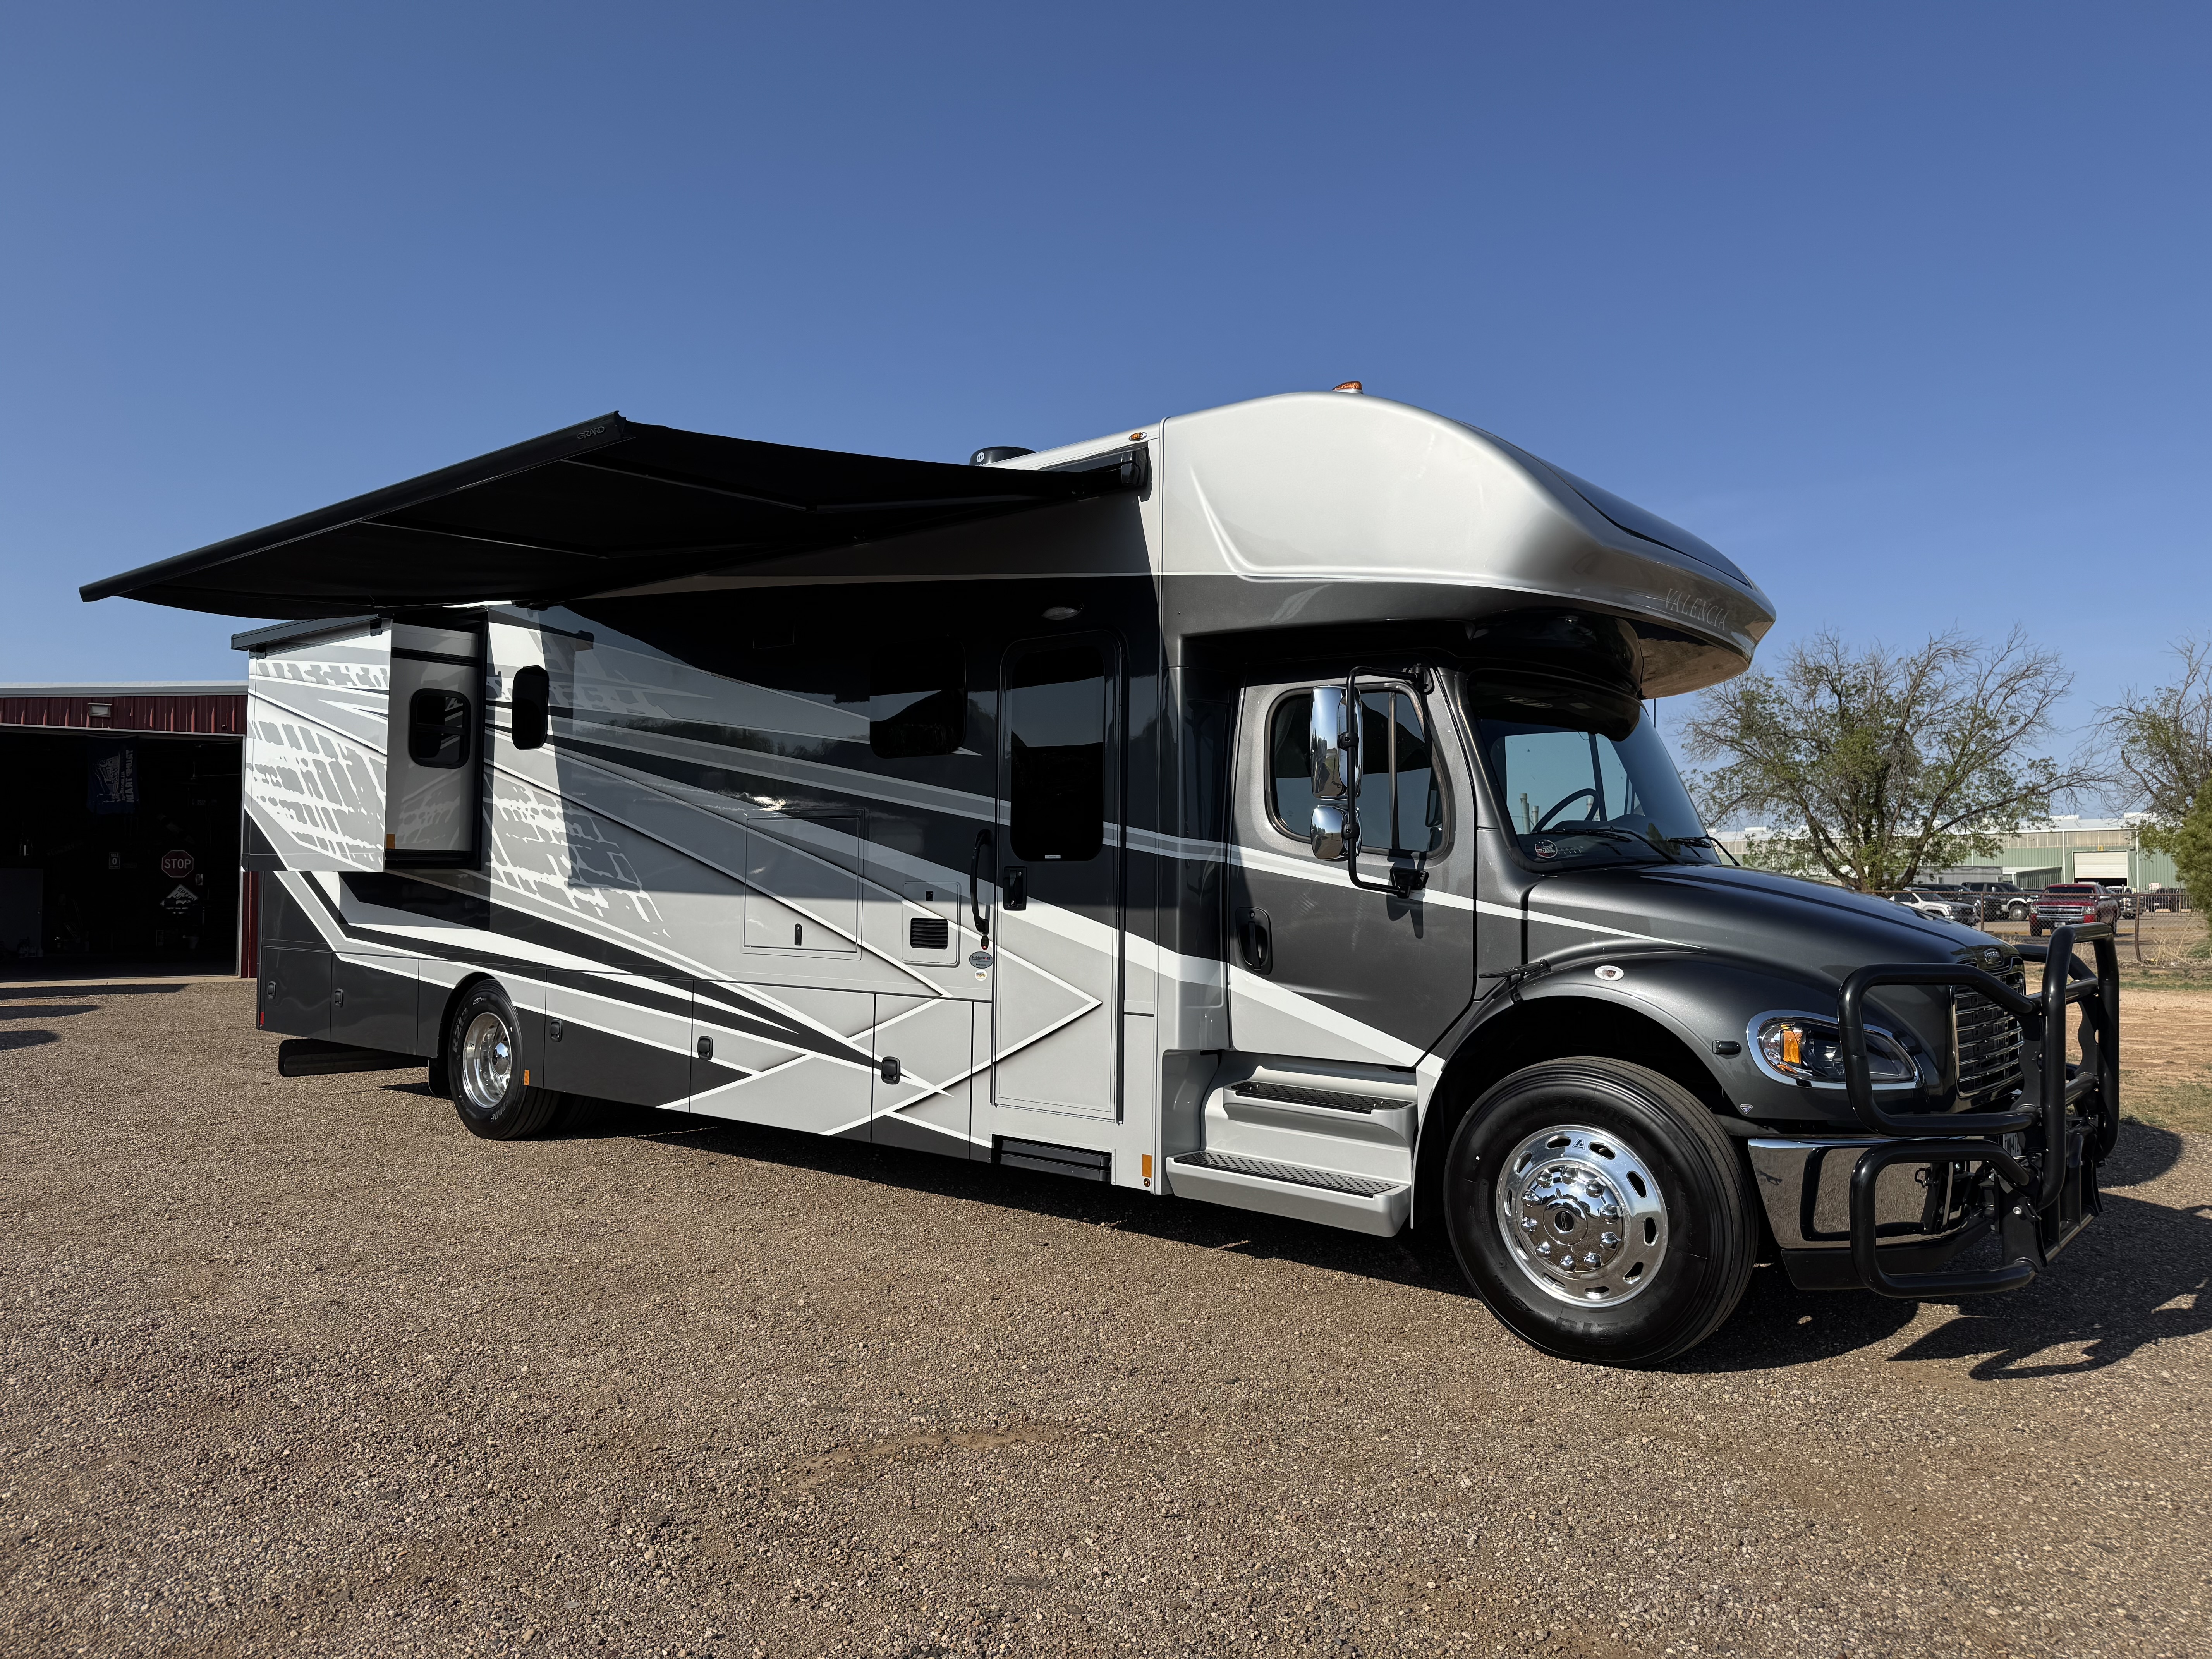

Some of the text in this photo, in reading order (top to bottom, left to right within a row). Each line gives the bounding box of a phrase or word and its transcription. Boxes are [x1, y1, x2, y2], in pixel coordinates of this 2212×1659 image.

[1665, 588, 1729, 630] VALENCIA
[164, 859, 191, 869] STOP
[452, 1007, 468, 1053] R213
